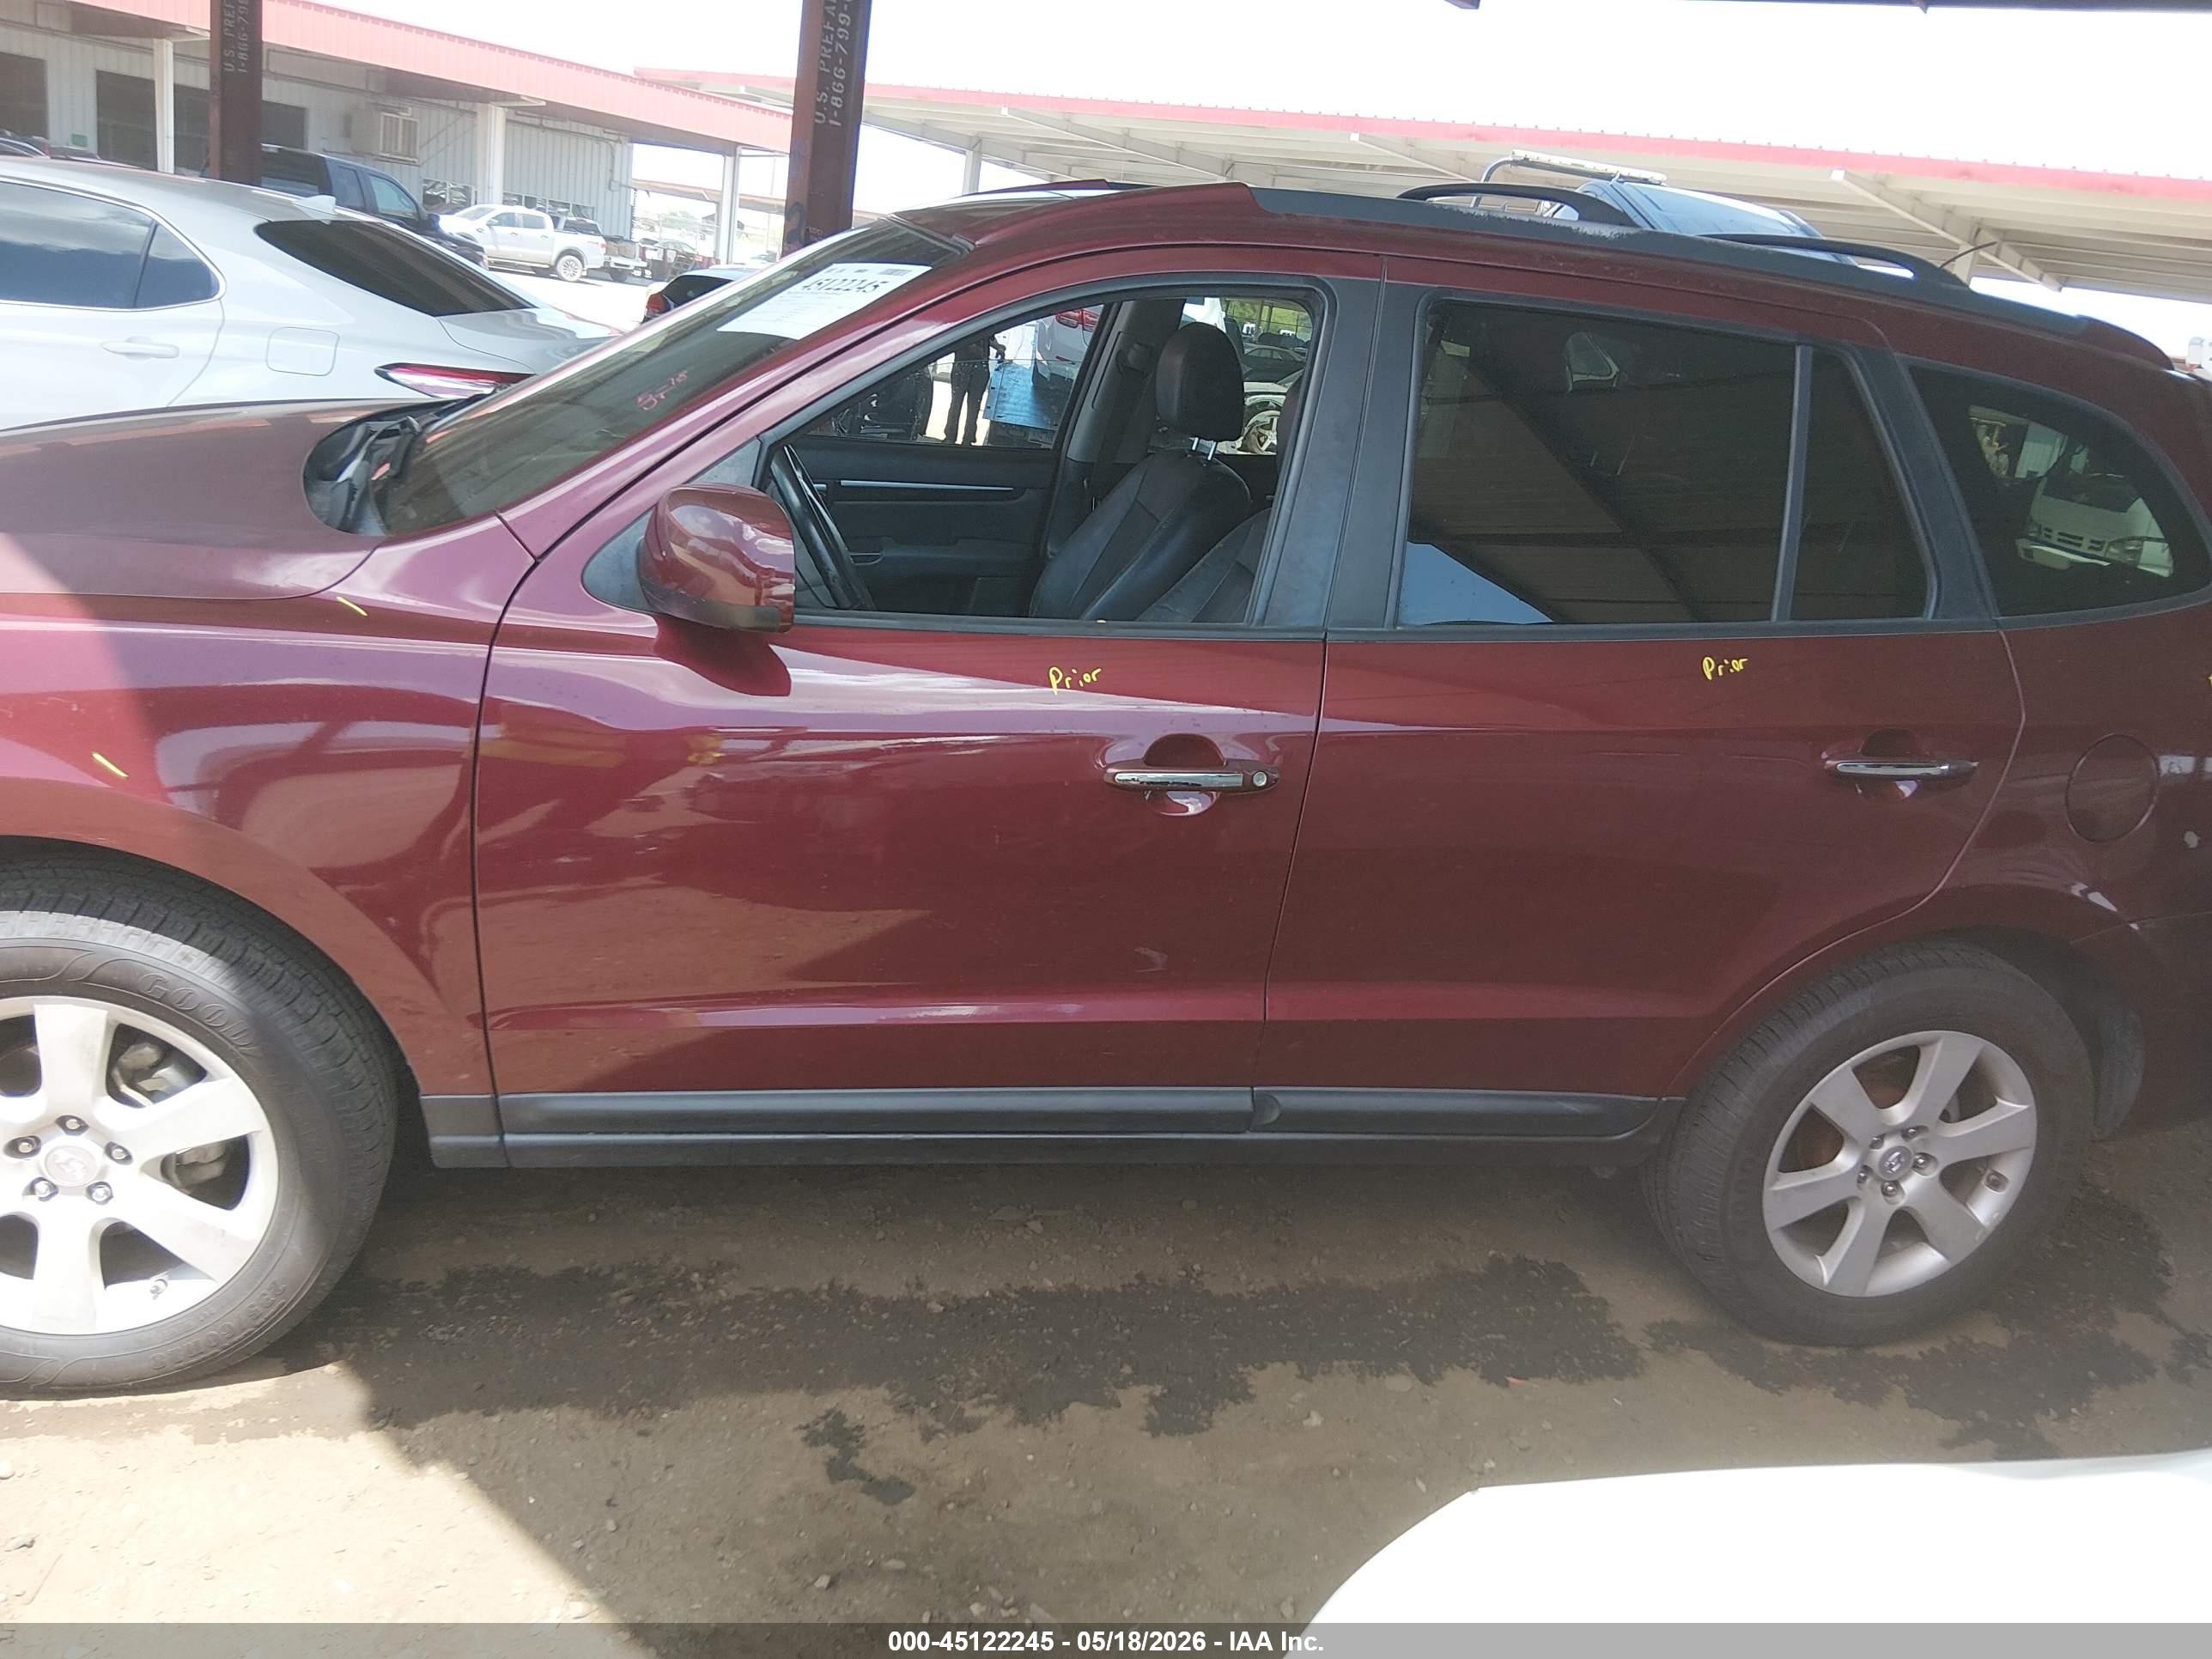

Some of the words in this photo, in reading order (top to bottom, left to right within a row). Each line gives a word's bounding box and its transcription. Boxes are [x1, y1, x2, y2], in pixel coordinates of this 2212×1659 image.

[819, 0, 837, 73] PREFA
[828, 0, 852, 127] 1-866-799-
[814, 86, 830, 125] U.S.
[1048, 666, 1103, 696] Prior
[1703, 657, 1749, 681] Prior
